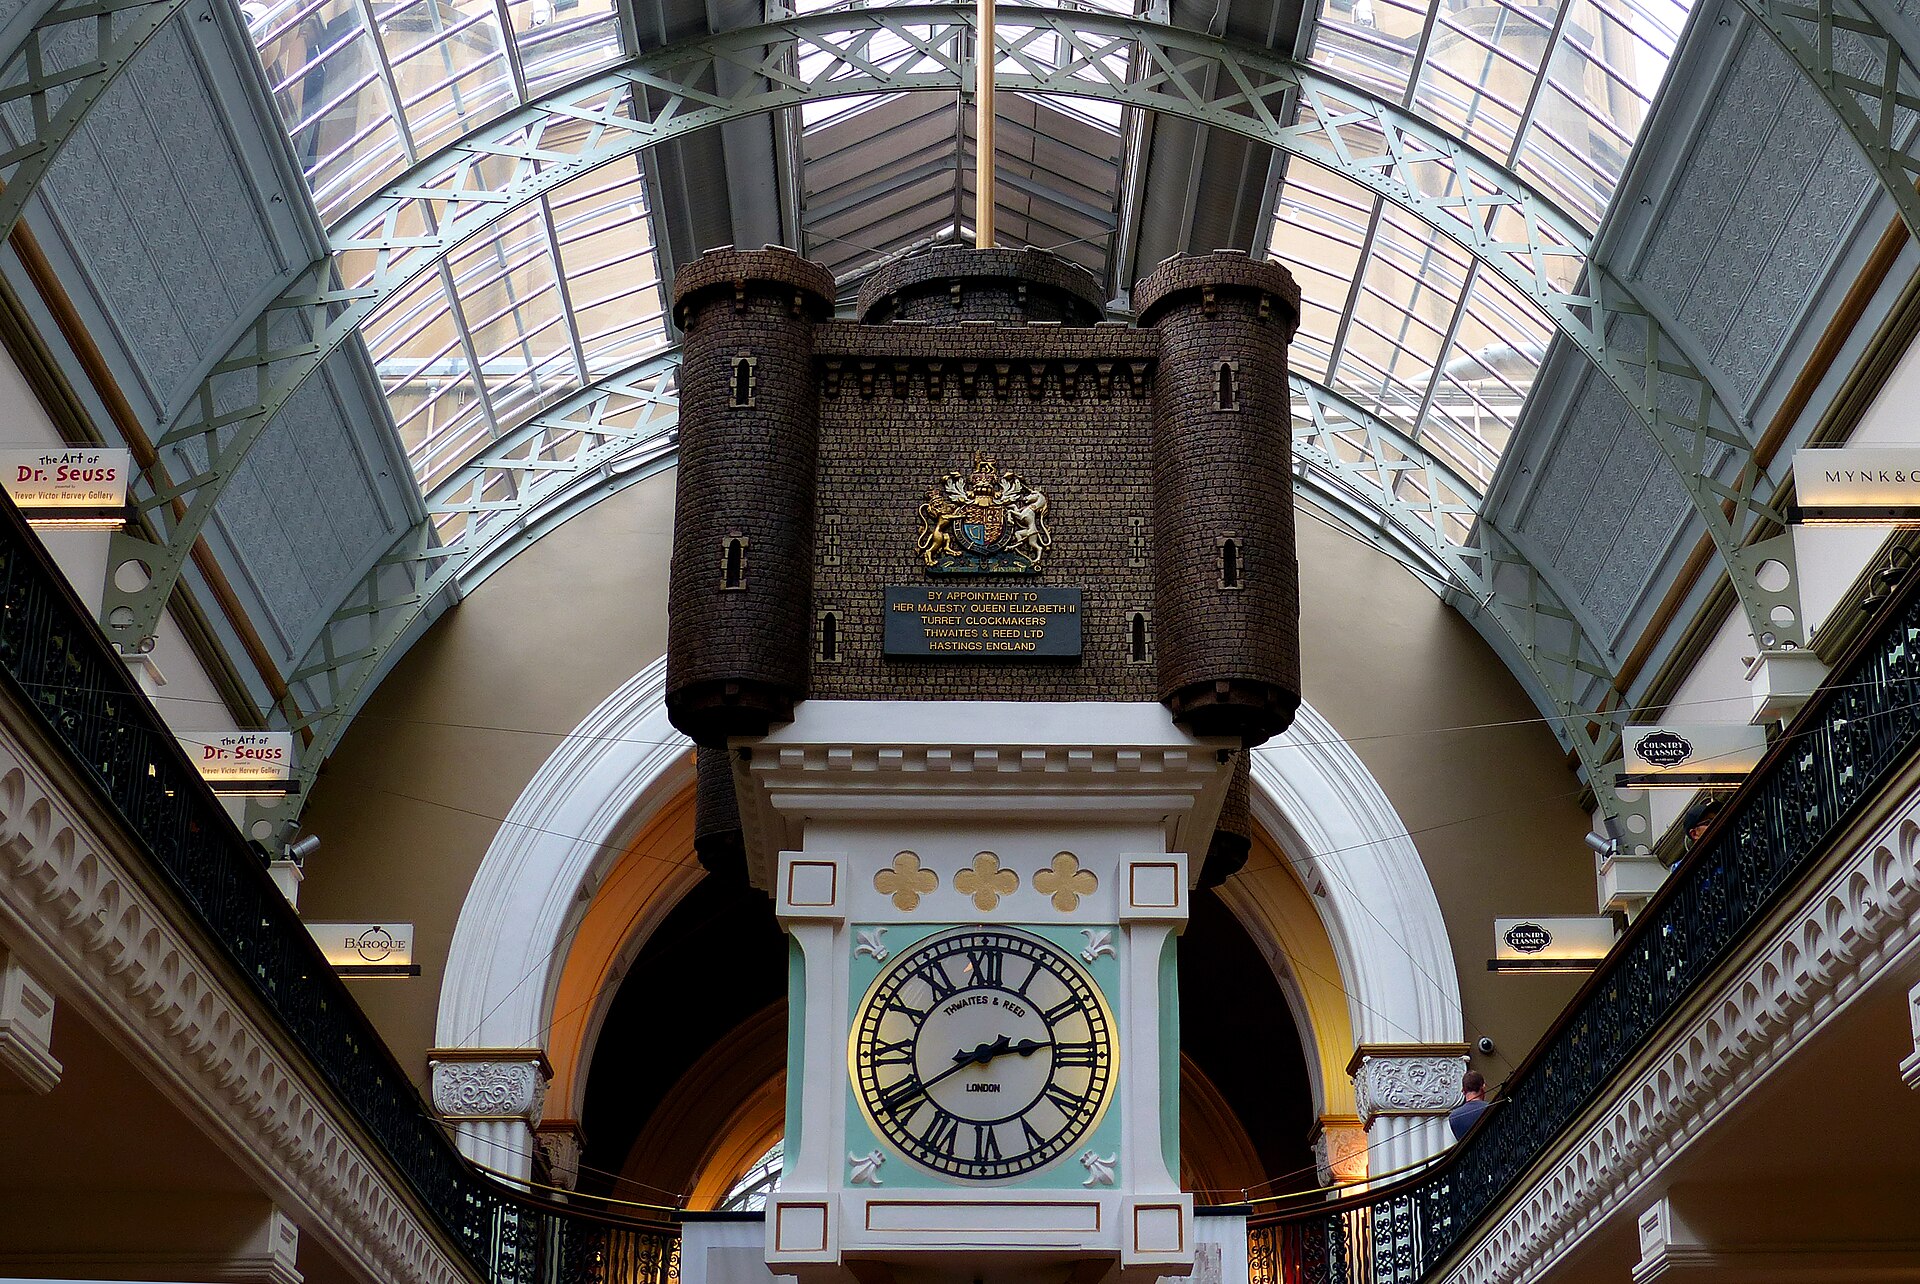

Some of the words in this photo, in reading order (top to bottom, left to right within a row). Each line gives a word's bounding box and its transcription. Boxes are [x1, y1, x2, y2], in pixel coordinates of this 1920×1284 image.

[39, 455, 58, 466] The
[60, 452, 84, 464] Art
[87, 455, 100, 464] of
[16, 465, 48, 482] Dr.
[56, 465, 116, 482] Seuss
[14, 491, 36, 500] Trevor
[38, 491, 59, 500] Victor
[61, 491, 86, 501] Harvey
[88, 491, 114, 501] Gallery
[928, 591, 943, 600] BY
[946, 591, 1020, 601] APPOINTMENT
[1022, 592, 1038, 601] TO
[892, 603, 914, 612] HER
[917, 603, 967, 613] MAJESTY
[970, 603, 1006, 613] QUEEN
[1009, 604, 1066, 613] ELIZABETH
[1069, 604, 1076, 613] II
[921, 615, 962, 625] TURRET
[965, 616, 1047, 626] CLOCKMAKERS
[924, 628, 979, 638] THWAITES
[981, 629, 989, 638] &
[992, 629, 1020, 638] REED
[1023, 629, 1044, 638] LTD
[929, 641, 983, 651] HASTINGS
[986, 642, 1036, 651] ENGLAND
[220, 737, 236, 746] The
[237, 735, 256, 745] Art
[259, 737, 269, 745] of
[1643, 741, 1683, 749] COUNTRY
[203, 745, 229, 760] Dr.
[235, 745, 282, 760] Seuss
[1643, 749, 1685, 757] CLASSICS
[966, 950, 1003, 988] XII
[886, 994, 926, 1028] X
[943, 995, 989, 1017] THWAITES
[992, 997, 999, 1006] &
[1002, 1000, 1026, 1018] REED
[1044, 993, 1084, 1027] II
[1054, 1041, 1093, 1069] III
[966, 1083, 1001, 1093] LONDON
[1019, 1115, 1046, 1152] V
